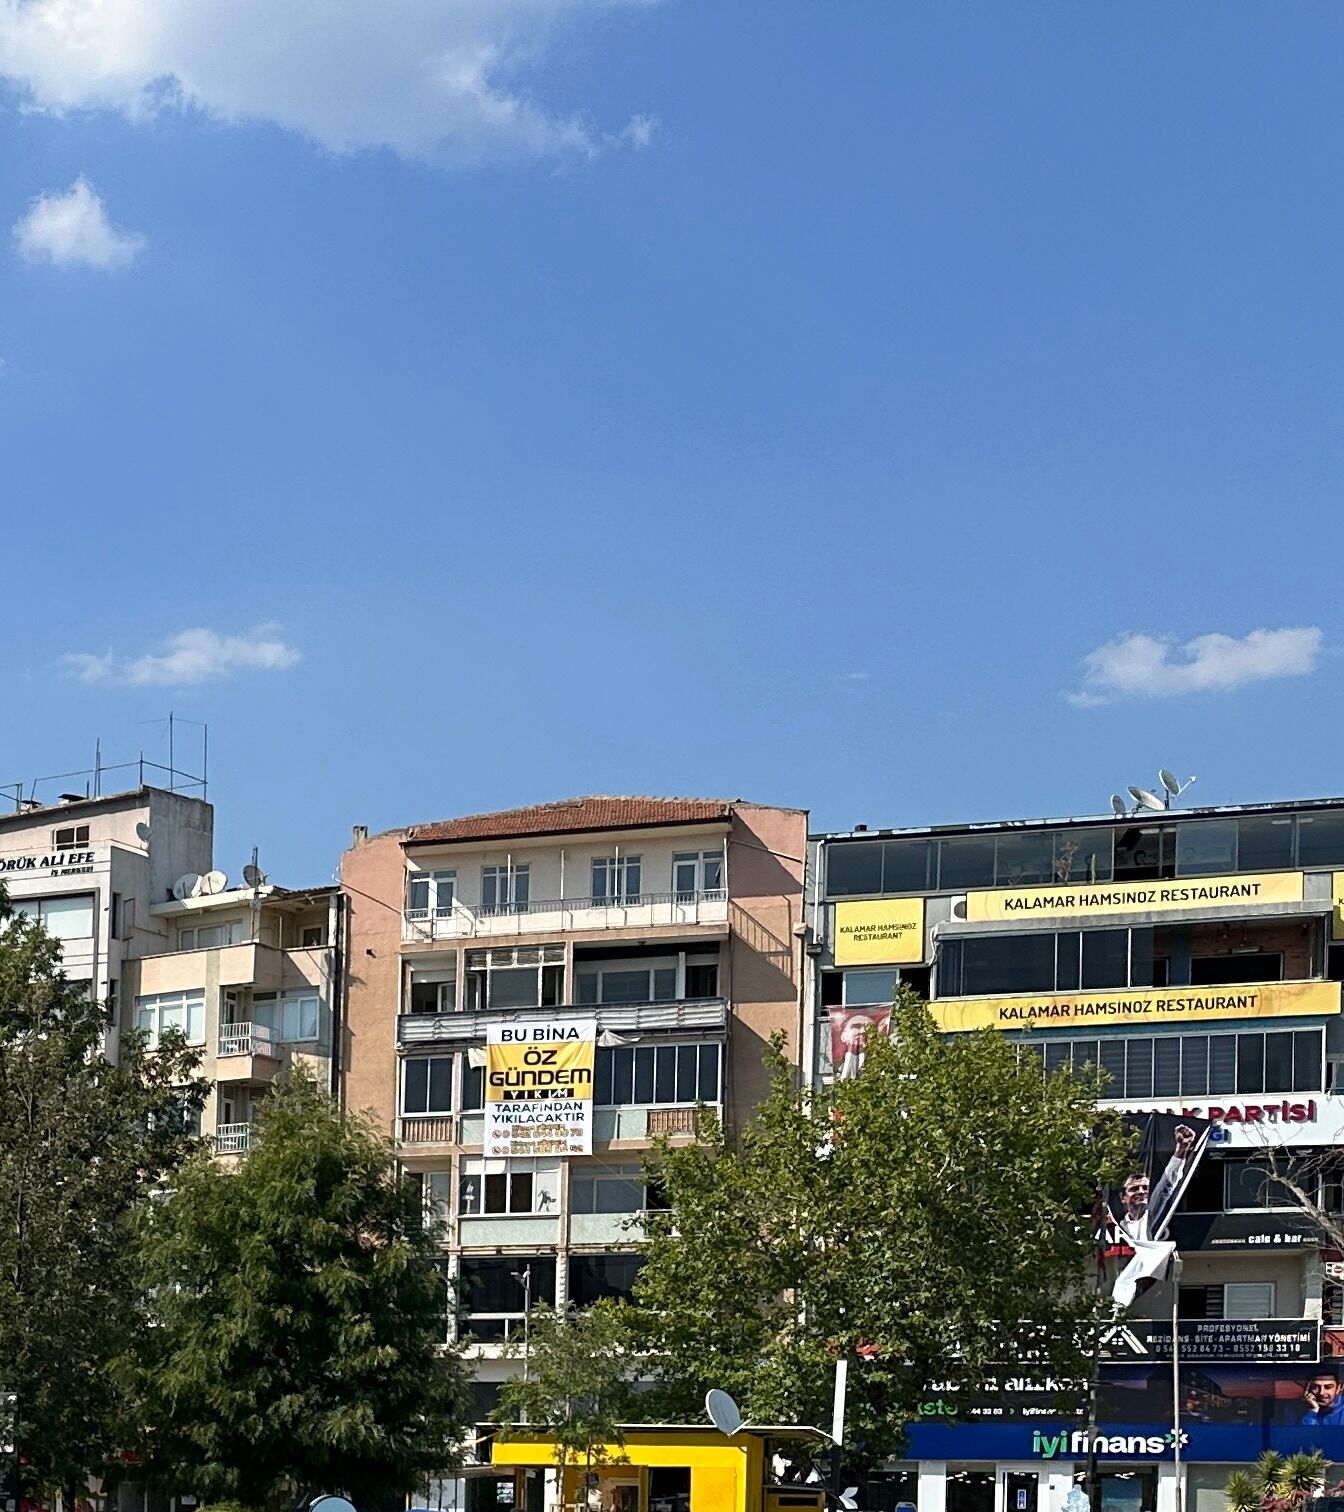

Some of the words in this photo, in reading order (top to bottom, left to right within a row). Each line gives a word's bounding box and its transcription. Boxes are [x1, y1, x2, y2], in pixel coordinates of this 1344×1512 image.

[40, 852, 65, 867] ALİ
[68, 852, 95, 864] EFE
[1004, 895, 1075, 911] KALAMAR
[1160, 883, 1262, 902] RESTAURANT
[840, 924, 876, 933] KALAMAR
[853, 932, 902, 941] RESTAURANT
[999, 1004, 1070, 1020] KALAMAR
[1156, 994, 1258, 1012] RESTAURANT
[502, 1029, 527, 1042] BU
[533, 1024, 579, 1041] BİNA
[523, 1046, 557, 1065] ÖZ
[489, 1067, 591, 1086] GÜNDEM
[511, 1088, 567, 1100] YIKIM
[492, 1113, 584, 1123] YIKILACAKTIR
[1208, 1100, 1315, 1123] PARTİSİ
[1197, 1324, 1259, 1332] PROFESYONEL
